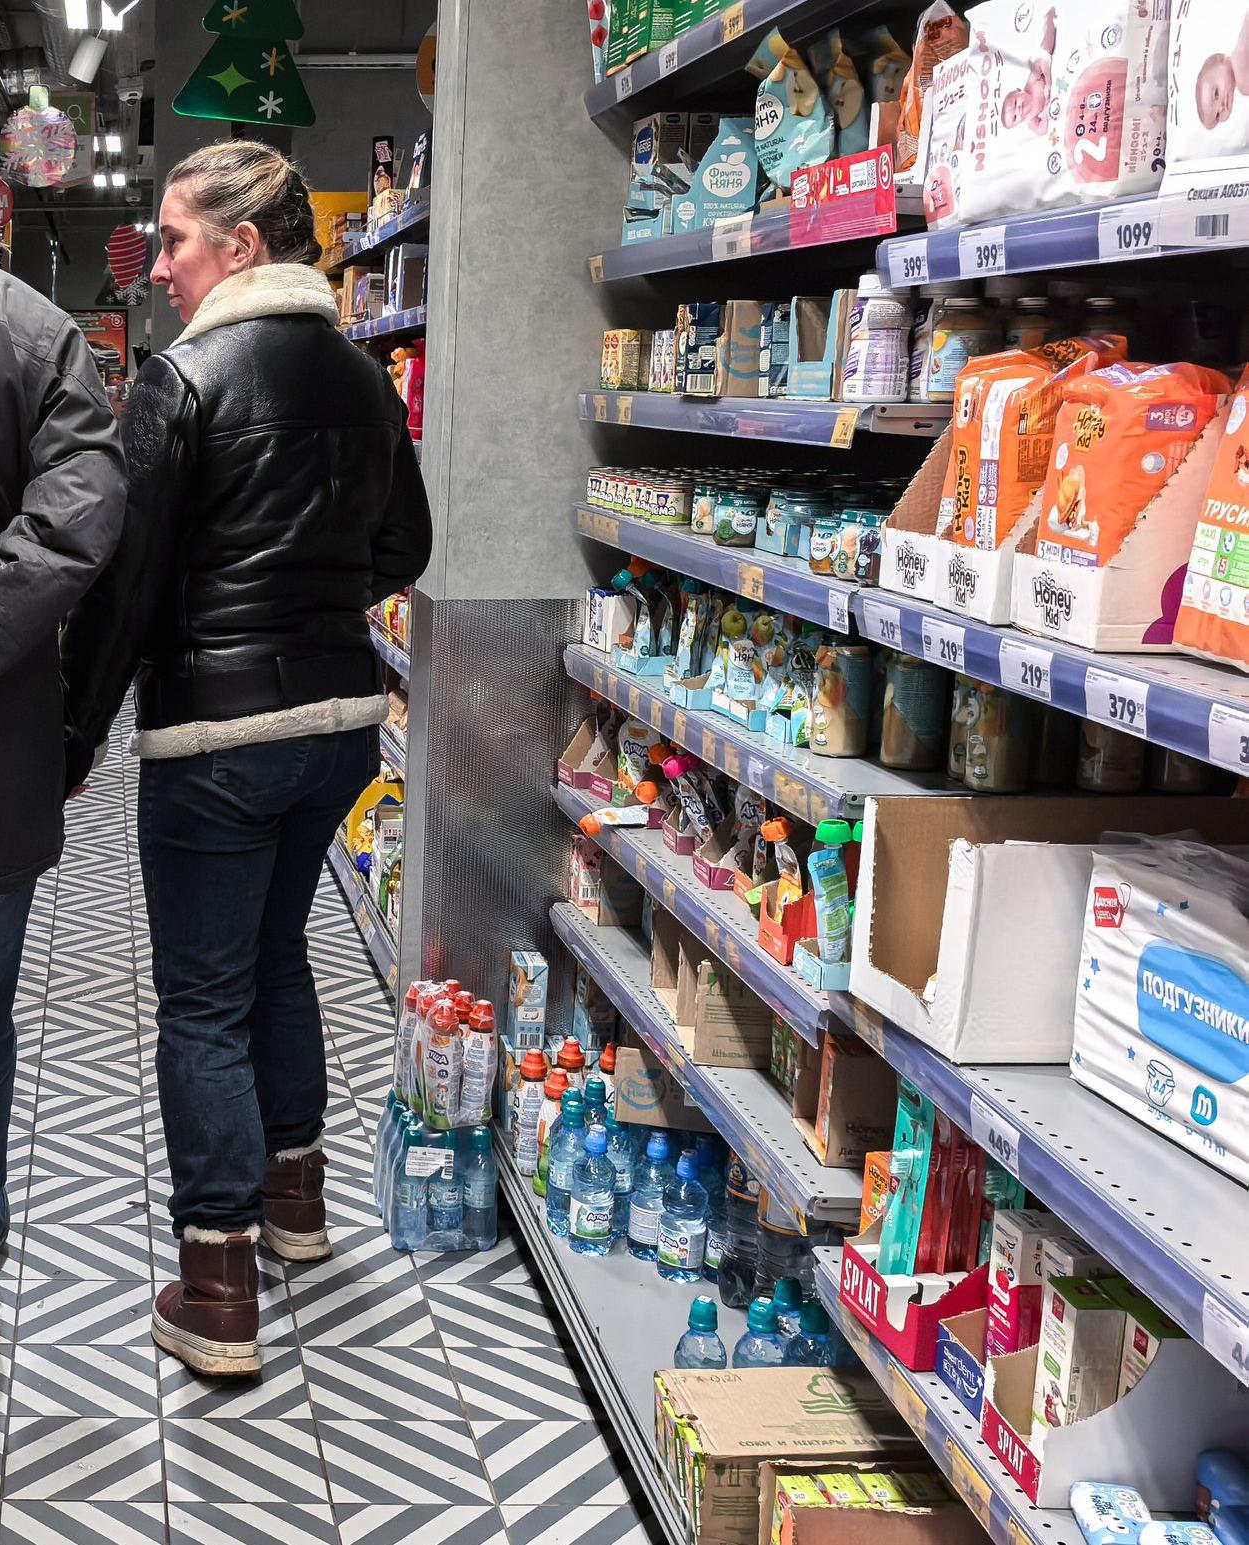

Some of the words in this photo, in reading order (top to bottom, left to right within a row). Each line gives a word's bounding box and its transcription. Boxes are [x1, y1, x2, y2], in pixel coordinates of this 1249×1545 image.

[1074, 136, 1107, 164] 2
[710, 177, 743, 190] НЯНЯ
[1116, 220, 1151, 250] 1099
[903, 255, 923, 280] 399
[975, 244, 999, 269] 399
[961, 477, 971, 509] Kid
[897, 546, 926, 578] Honey
[903, 568, 915, 587] Kid
[955, 587, 966, 606] Kid
[1034, 579, 1073, 619] Honey
[880, 618, 895, 640] 219
[1044, 607, 1060, 629] Kid
[940, 638, 958, 662] 219
[1021, 661, 1043, 689] 219
[1109, 693, 1137, 724] 379
[1141, 969, 1249, 1045] ПОДГУЗНИКИ
[1153, 1080, 1167, 1097] 44
[987, 1128, 1011, 1161] 449
[842, 1257, 882, 1318] SPLAT
[997, 1424, 1026, 1476] SPLAT
